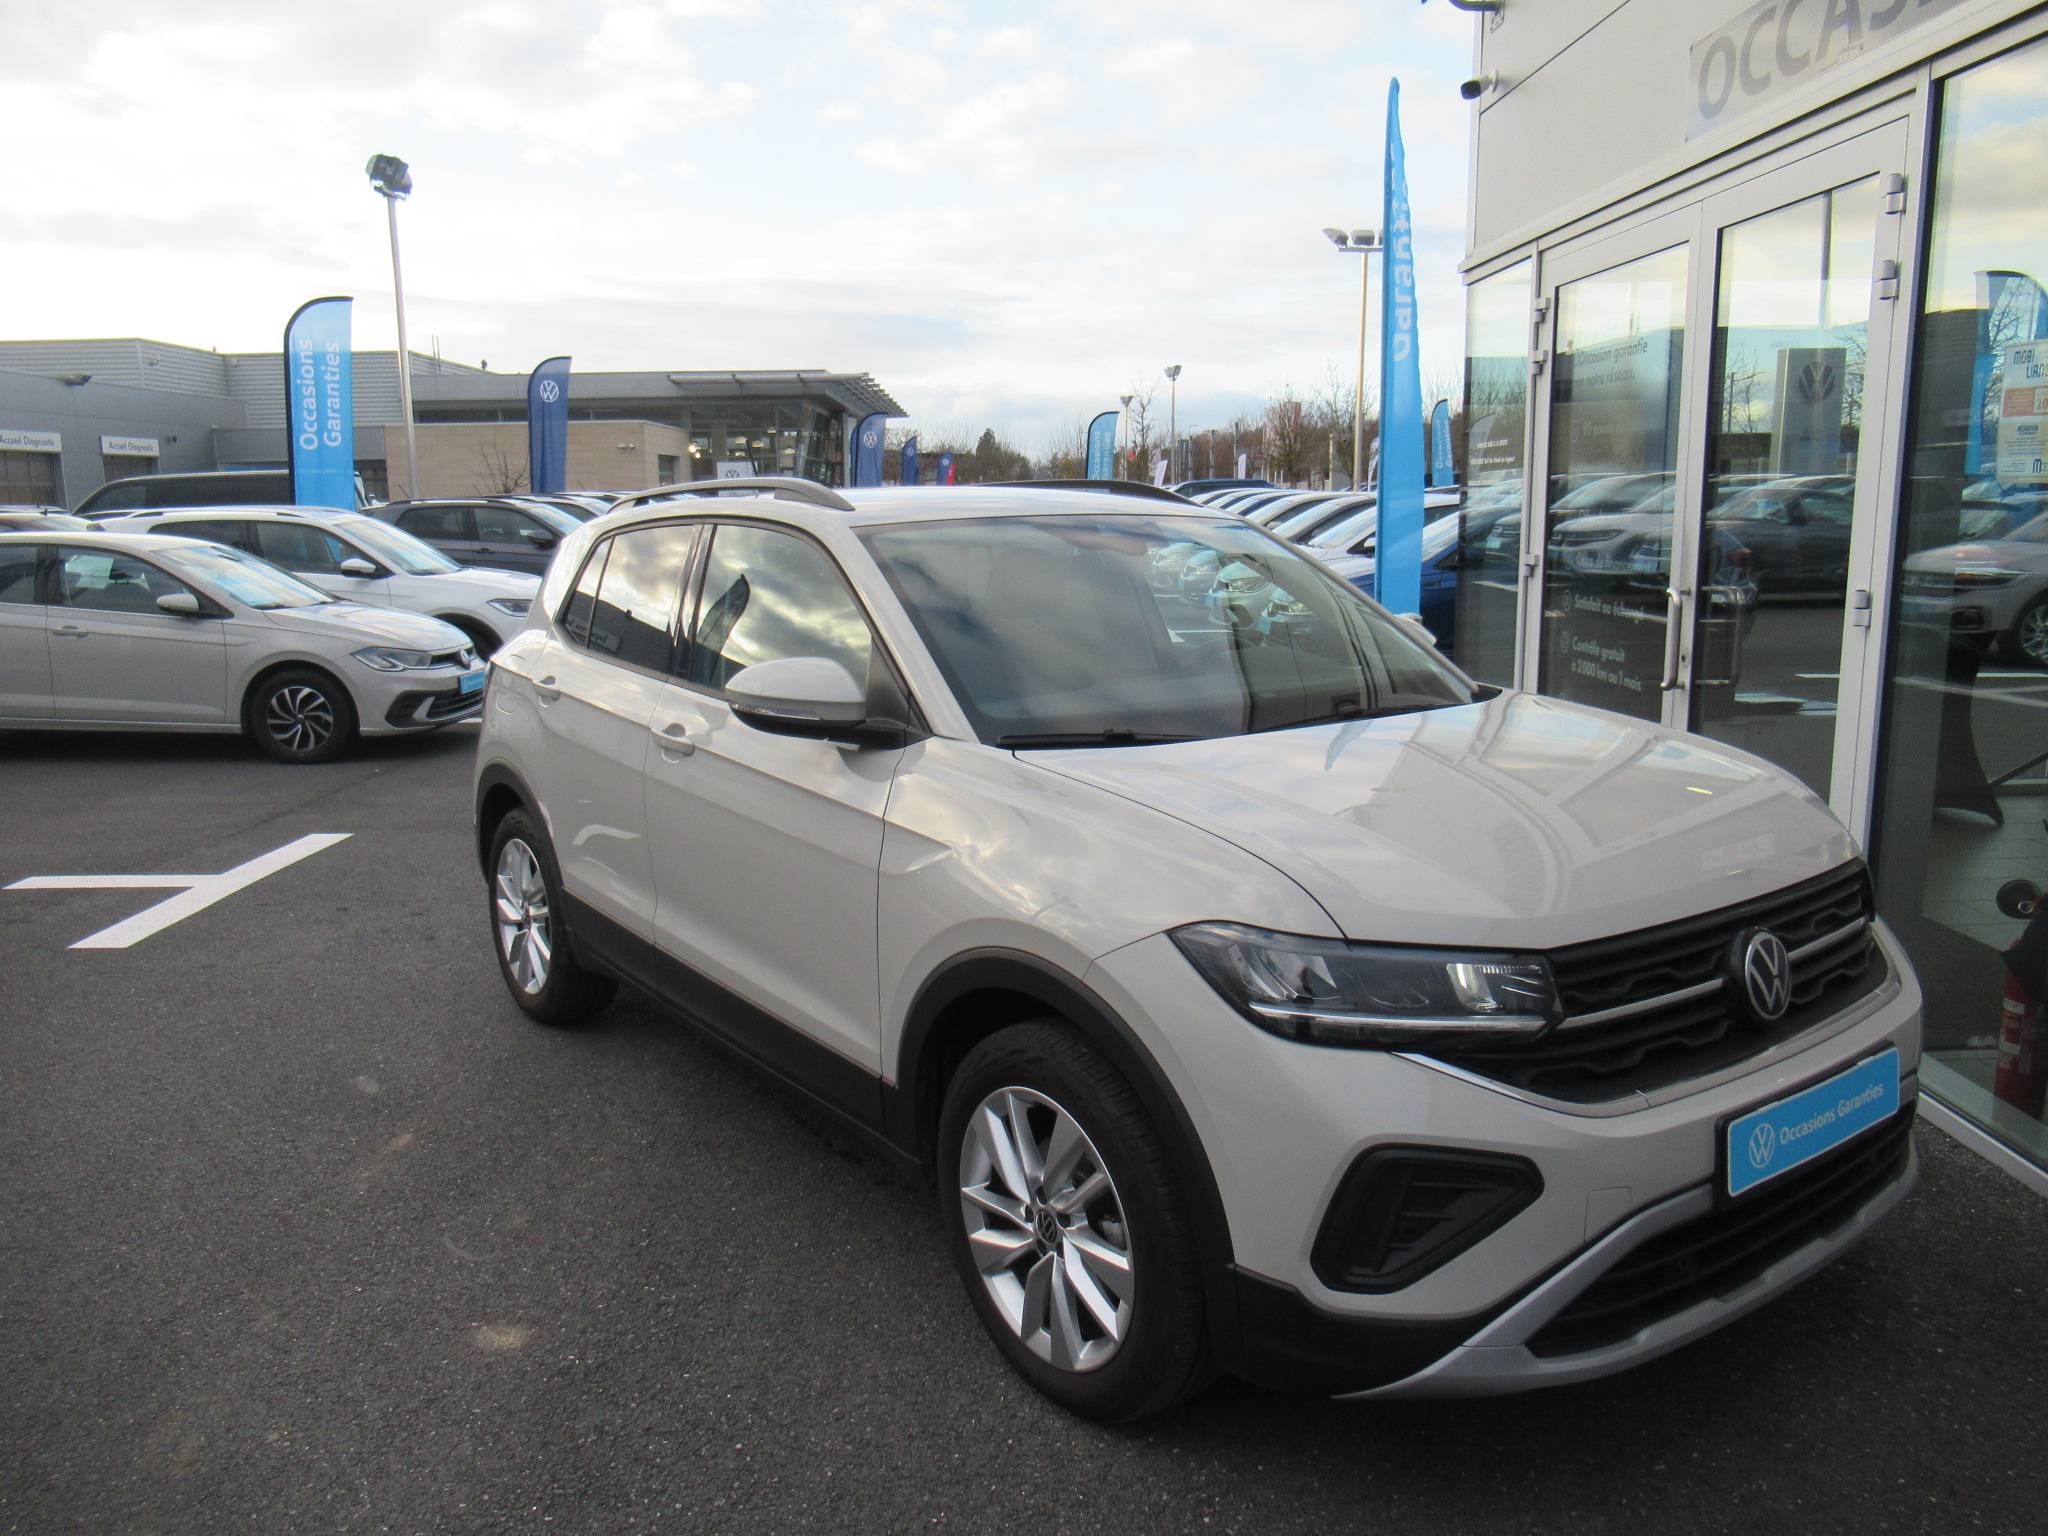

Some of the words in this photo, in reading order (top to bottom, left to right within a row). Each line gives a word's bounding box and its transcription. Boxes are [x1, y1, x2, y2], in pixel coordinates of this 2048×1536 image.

[1698, 0, 1938, 119] OCCA
[298, 338, 319, 451] Occasions
[321, 340, 343, 447] Garanties
[1572, 636, 1601, 656] Contrôle
[1624, 678, 1641, 692] mois
[1780, 1110, 1836, 1145] Occasions
[1837, 1083, 1884, 1118] Garanties
